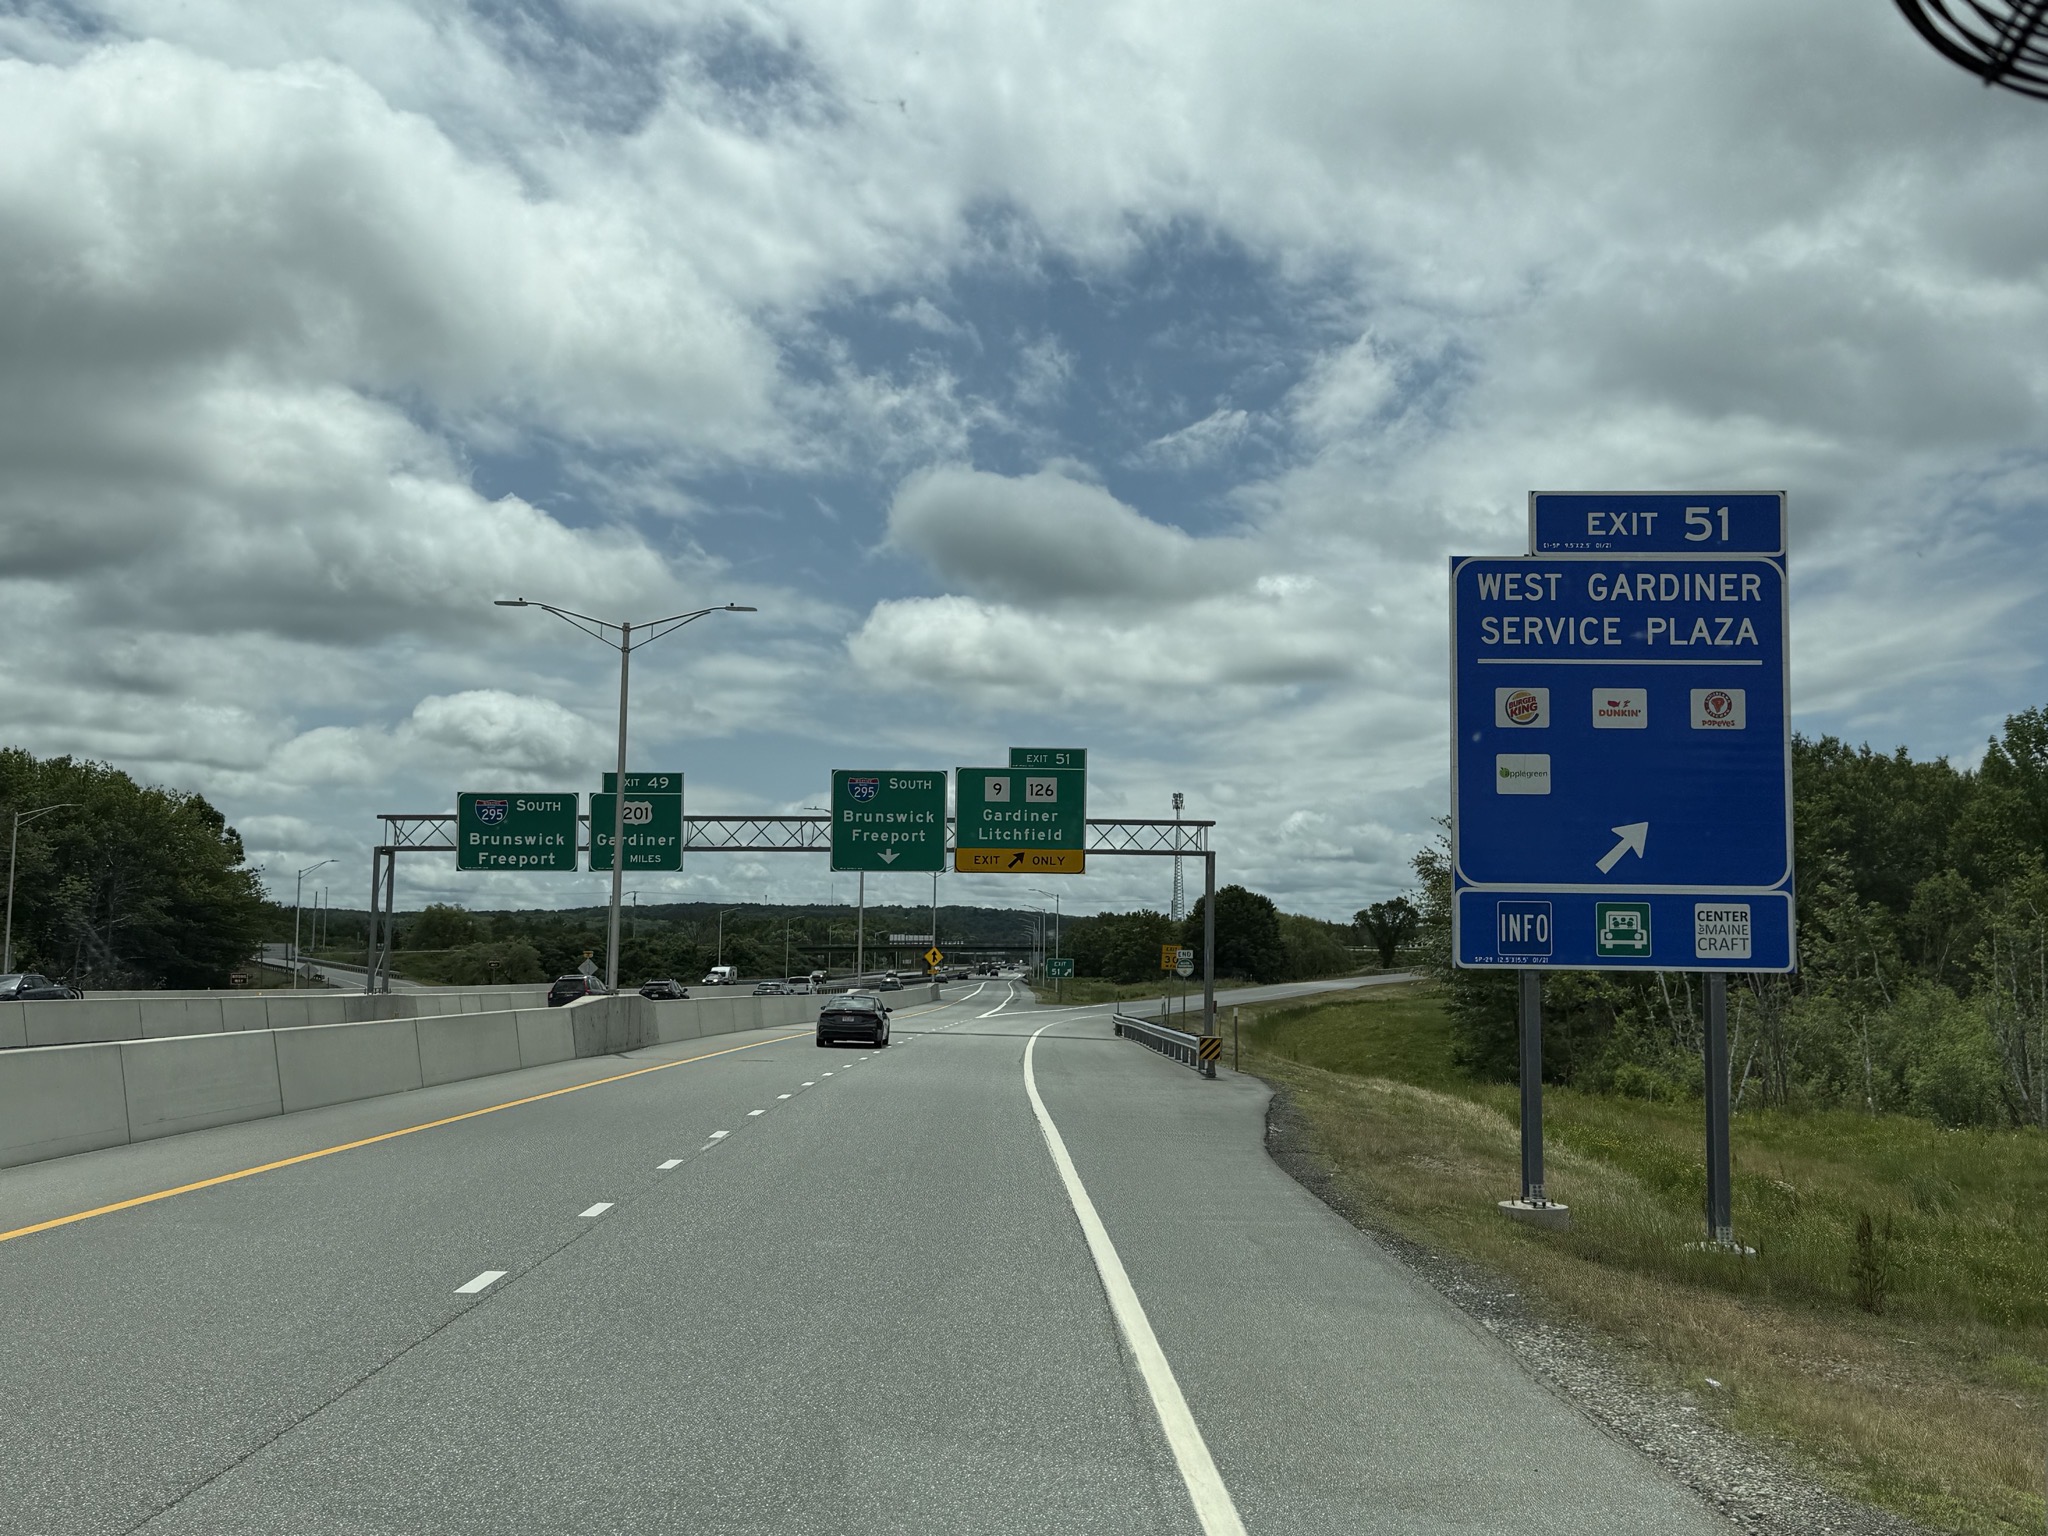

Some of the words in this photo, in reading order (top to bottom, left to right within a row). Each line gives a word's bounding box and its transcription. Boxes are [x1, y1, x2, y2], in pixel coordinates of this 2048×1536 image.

[1588, 513, 1657, 535] EXIT
[1685, 507, 1728, 541] 51
[1477, 573, 1562, 601] WEST
[1587, 573, 1761, 602] GARDINER
[1481, 617, 1622, 646] SERVICE
[1647, 617, 1759, 646] PLAZA
[1508, 696, 1537, 709] BURGER
[1509, 702, 1538, 718] KING
[1599, 709, 1641, 717] DUNKIN'
[1026, 754, 1048, 763] EXIT
[1056, 753, 1070, 765] 51
[1505, 770, 1548, 779] applegreen
[624, 778, 640, 787] XIT
[647, 777, 669, 789] 49
[854, 786, 875, 798] 295
[889, 778, 932, 790] SOUTH
[993, 783, 1002, 796] 9
[1029, 783, 1054, 797] 126
[481, 808, 503, 821] 295
[516, 799, 561, 812] SOUTH
[623, 806, 649, 820] 201
[843, 810, 934, 823] Brunswick
[983, 809, 1058, 822] Gardiner
[469, 833, 564, 846] Brunswick
[852, 829, 926, 845] Freeport
[978, 827, 1062, 841] Litchfield
[478, 852, 556, 868] Freeport
[629, 854, 662, 863] MILES
[974, 855, 1001, 865] EXIT
[1032, 855, 1066, 866] ONLY
[1697, 910, 1748, 922] CENTER
[1501, 913, 1548, 943] INFO
[1705, 924, 1749, 936] MAINE
[1697, 937, 1749, 951] CRAFT
[1051, 968, 1060, 976] 51
